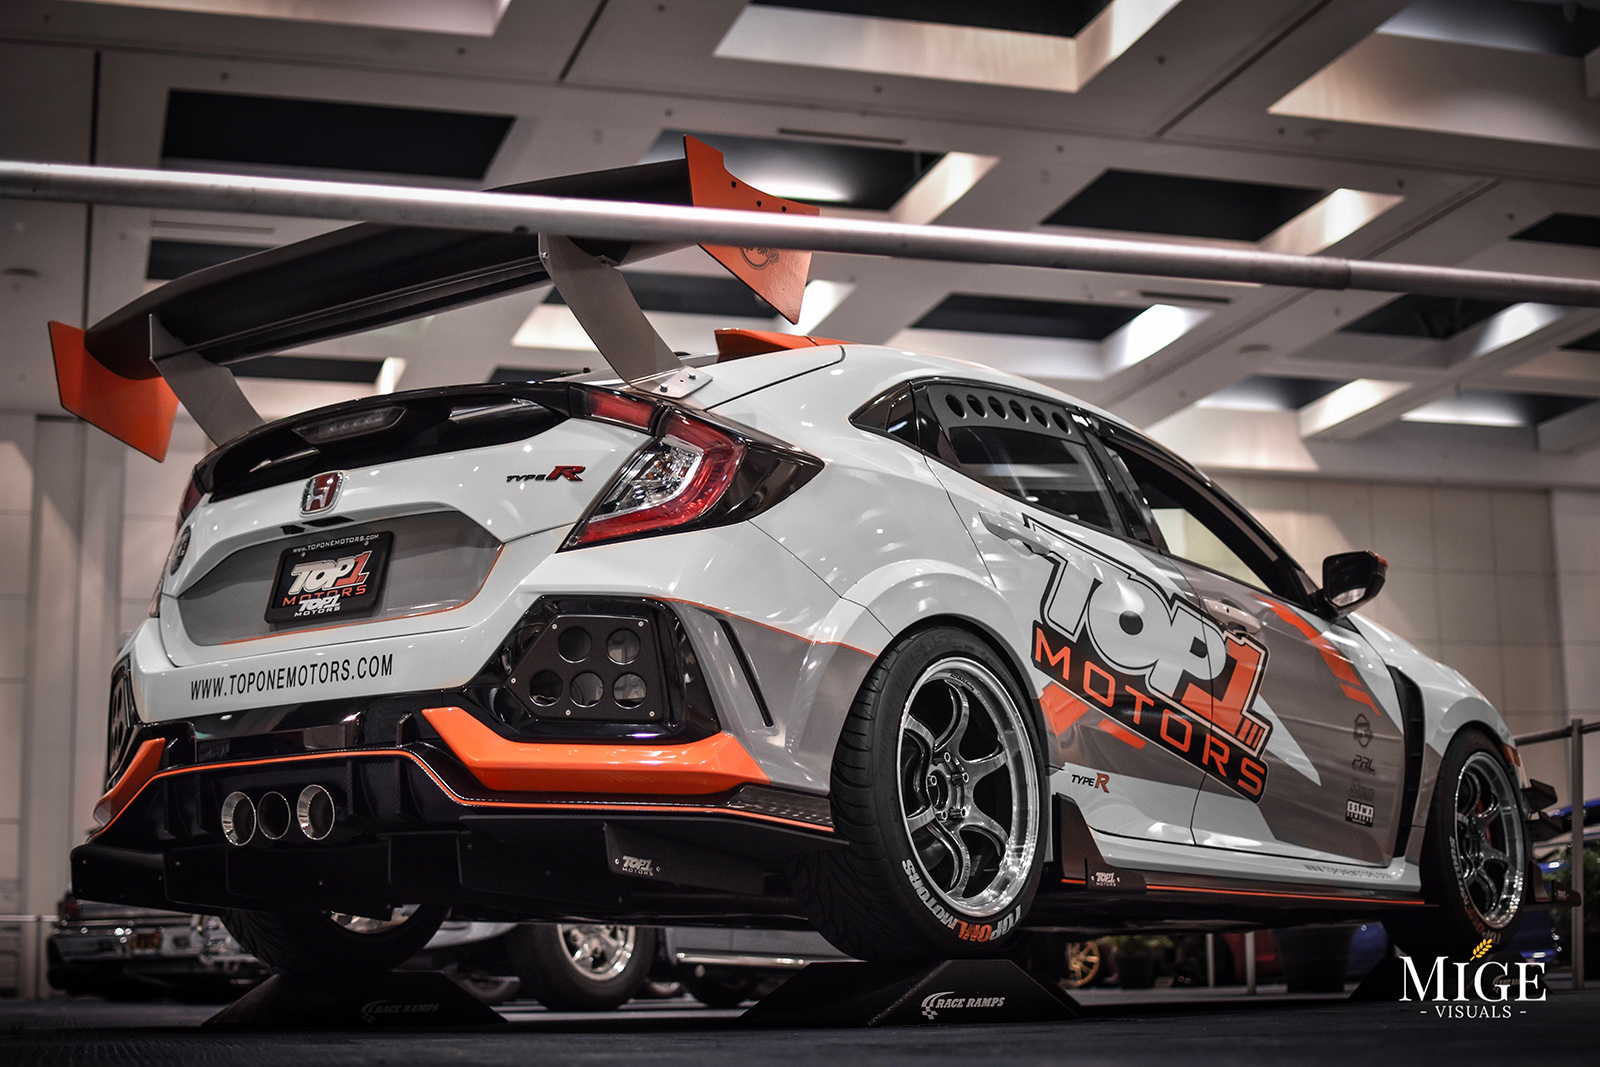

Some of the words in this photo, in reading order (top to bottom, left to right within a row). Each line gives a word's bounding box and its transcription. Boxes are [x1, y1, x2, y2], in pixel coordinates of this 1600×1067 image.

[294, 605, 342, 618] MOTORS
[299, 594, 342, 612] TOP1
[191, 653, 394, 701] WWW.TOPONEMOTORS.COM
[1035, 627, 1266, 797] MOTORS
[1071, 774, 1096, 788] TYPE
[1094, 772, 1110, 794] R
[622, 867, 654, 877] MOTORS
[902, 859, 959, 930] MOTORS
[990, 904, 1021, 941] TOP
[935, 998, 966, 1009] RACE
[965, 997, 1006, 1008] RAMPS
